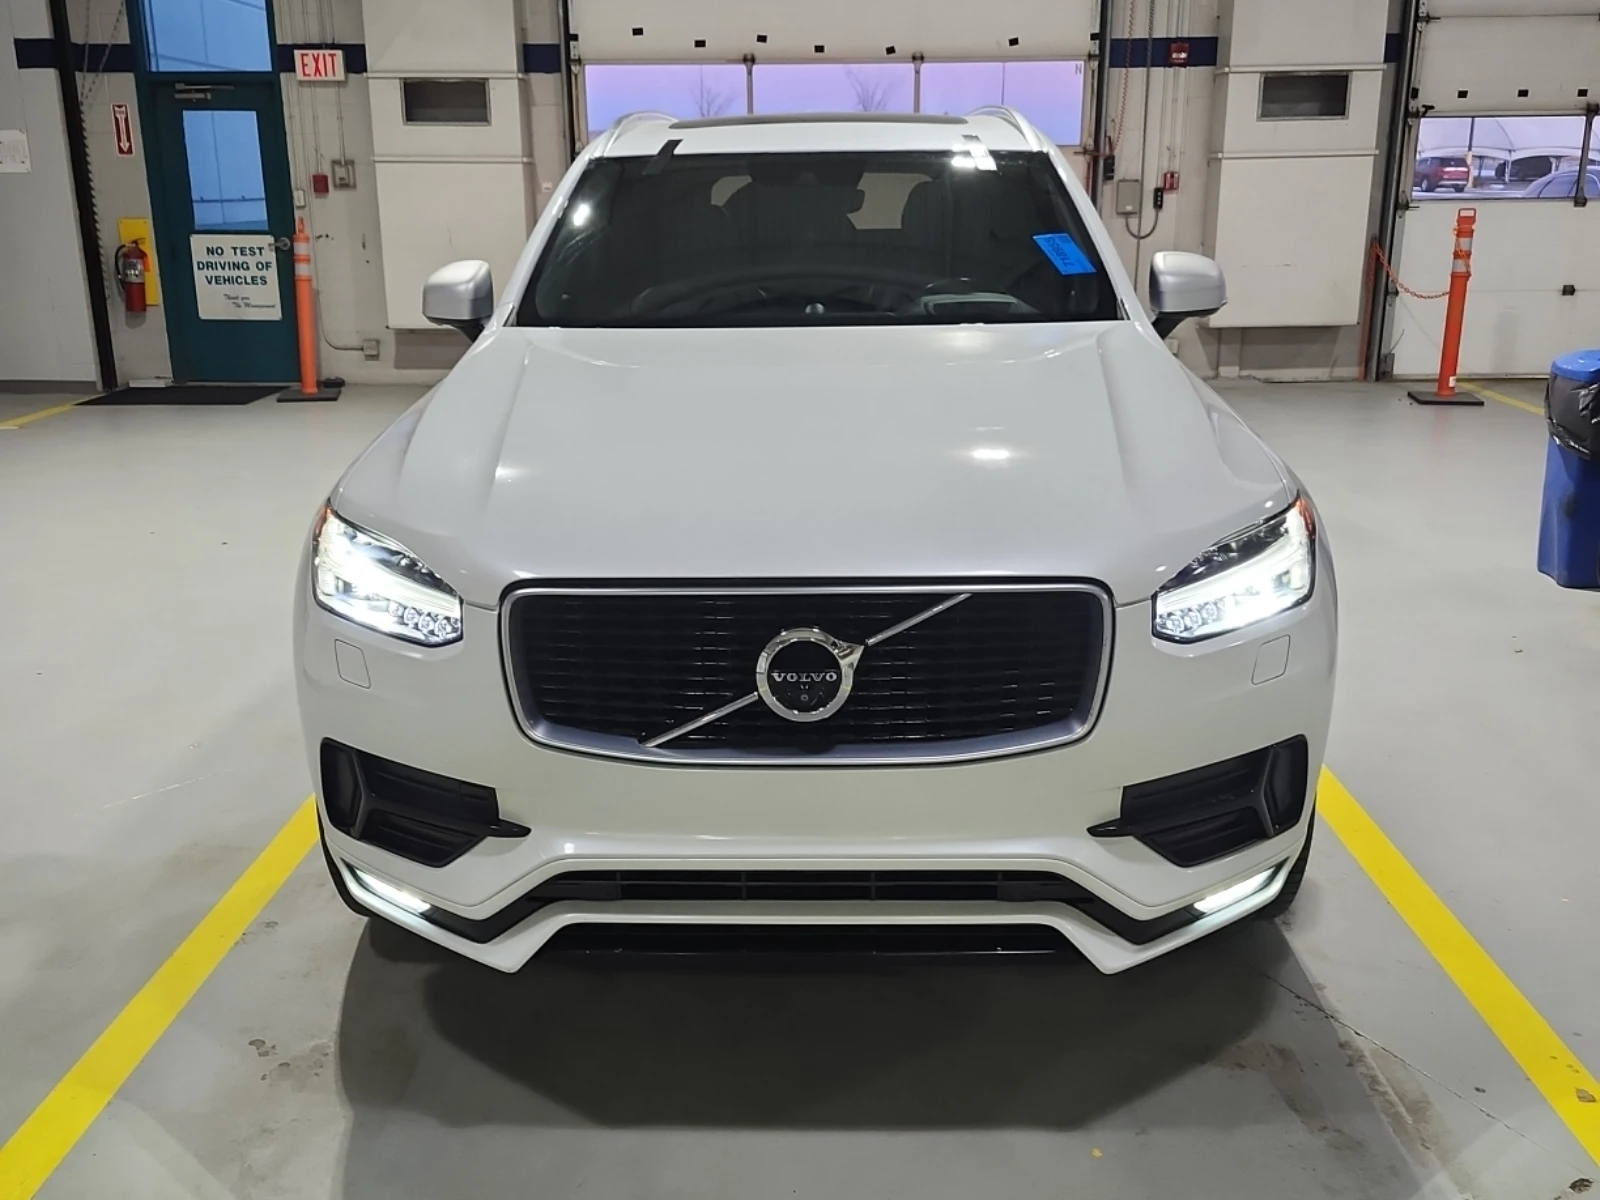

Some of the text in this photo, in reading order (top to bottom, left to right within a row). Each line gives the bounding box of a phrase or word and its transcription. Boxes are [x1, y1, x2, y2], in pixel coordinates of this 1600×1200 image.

[300, 52, 337, 77] EXIT
[206, 246, 264, 256] NO TEST
[197, 261, 272, 271] DRIVING OF
[205, 275, 268, 285] VEHICLES
[770, 671, 838, 682] VOLVO
